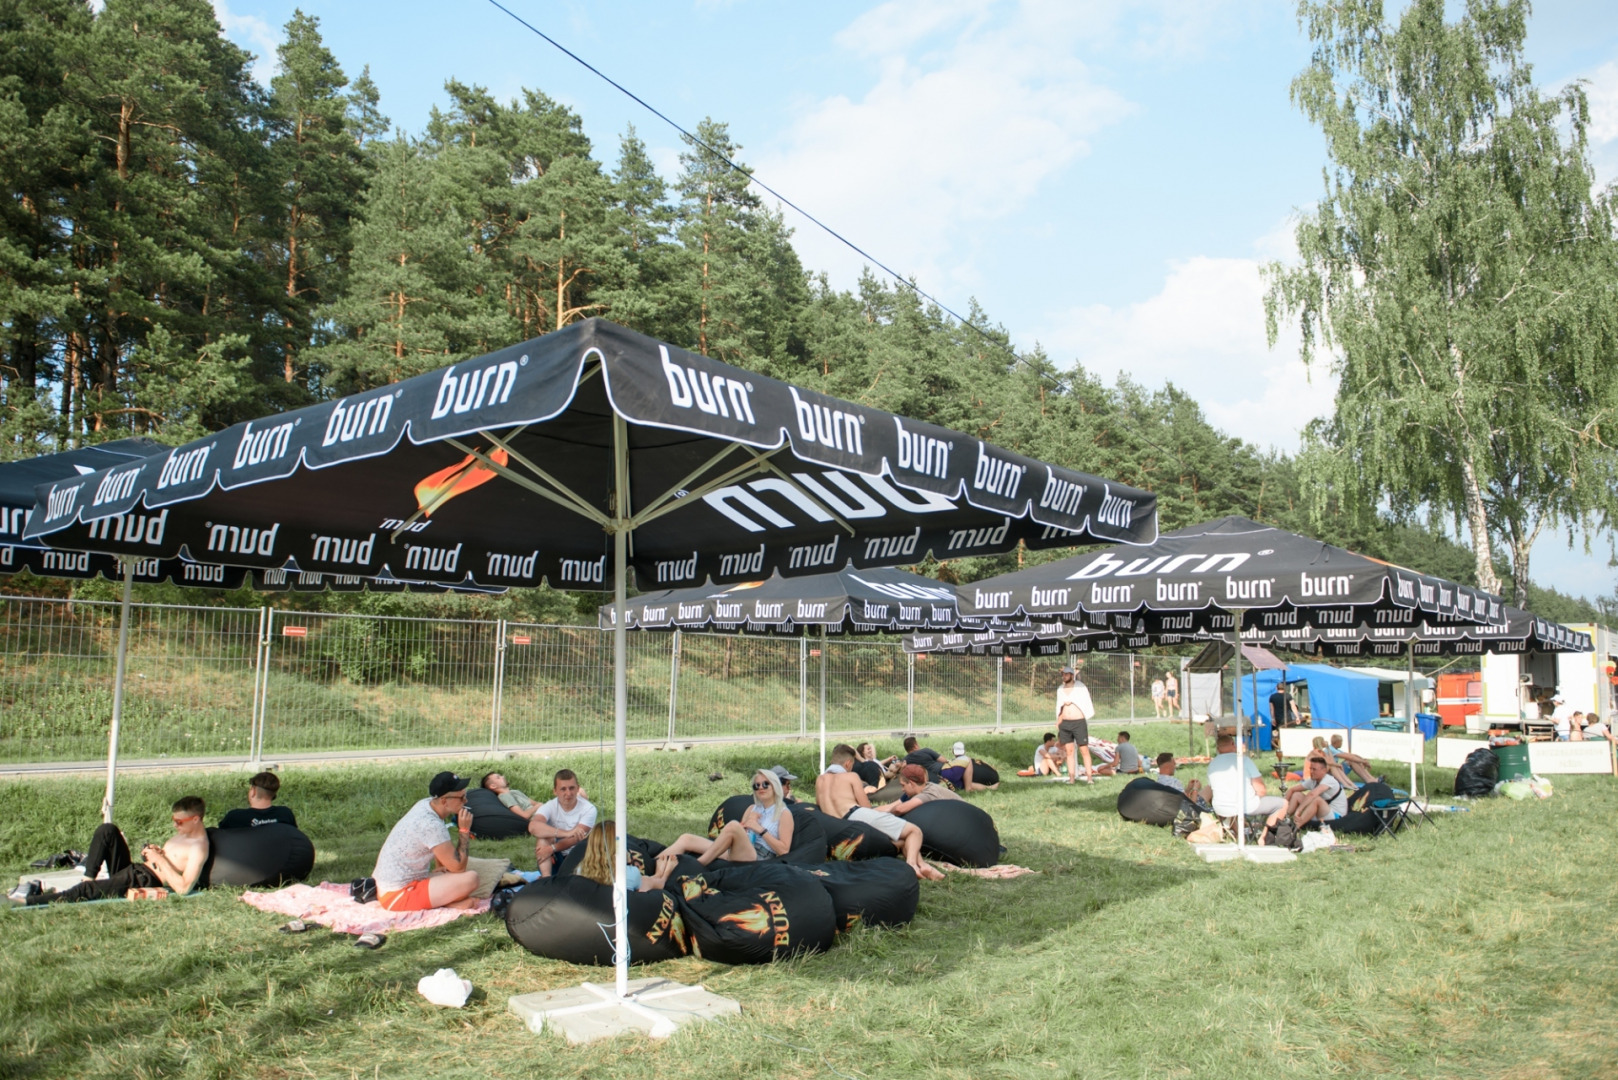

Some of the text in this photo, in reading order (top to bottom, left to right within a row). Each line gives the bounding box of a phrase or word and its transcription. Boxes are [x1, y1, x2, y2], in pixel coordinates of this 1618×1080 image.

[93, 465, 140, 506] burn
[157, 446, 210, 490] burn
[232, 422, 293, 470] burn
[322, 399, 394, 447] burn
[431, 361, 518, 420] burn
[659, 345, 755, 424] burn
[789, 386, 862, 455] burn
[893, 417, 948, 479] burn
[974, 441, 1022, 498] burn
[1040, 466, 1084, 516] burn
[1065, 552, 1251, 580] burn
[643, 606, 664, 622] burn
[678, 602, 702, 620] burn
[716, 600, 740, 618] burn
[755, 600, 782, 618] burn
[798, 600, 825, 618] burn
[975, 572, 1350, 609] burn burn burn burn burn burn
[760, 890, 790, 947] BURN
